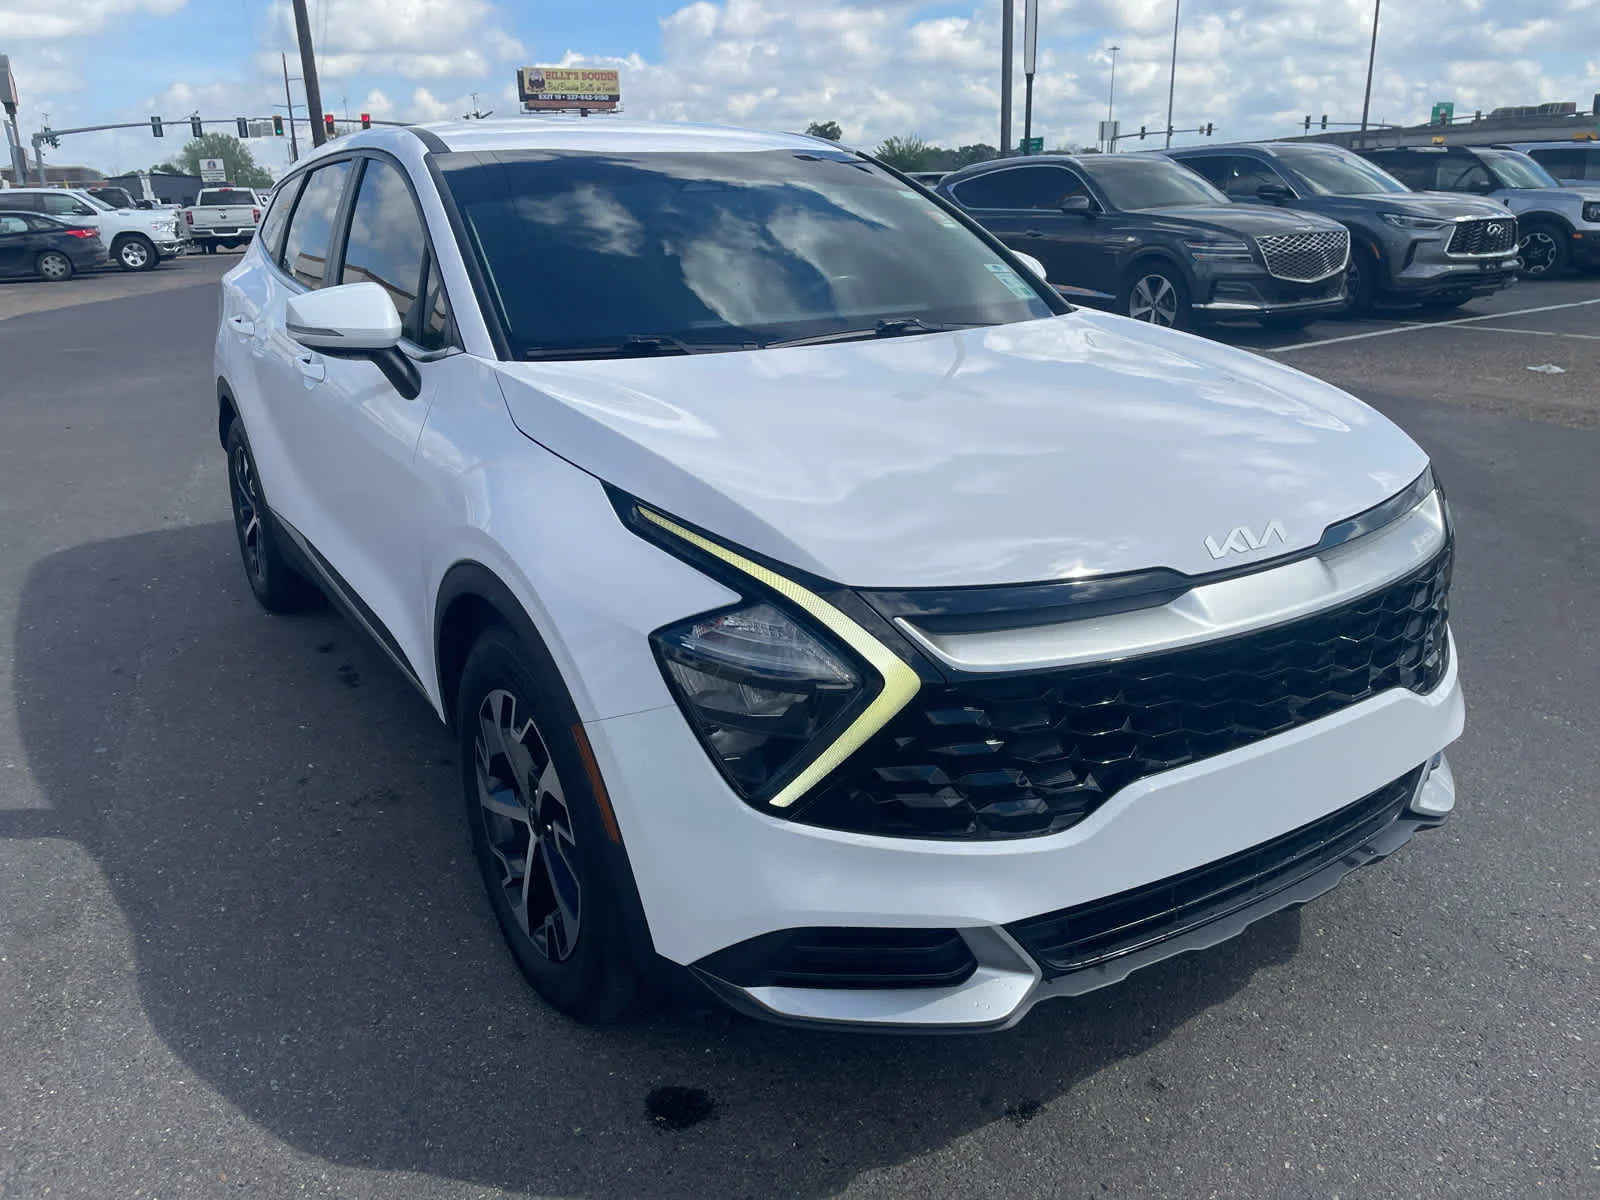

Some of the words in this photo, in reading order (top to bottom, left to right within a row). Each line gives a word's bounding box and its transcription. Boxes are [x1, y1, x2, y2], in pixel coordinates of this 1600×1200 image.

[545, 71, 579, 80] BILLY'S
[581, 71, 617, 81] BOUDIN
[1203, 519, 1287, 560] KIA
